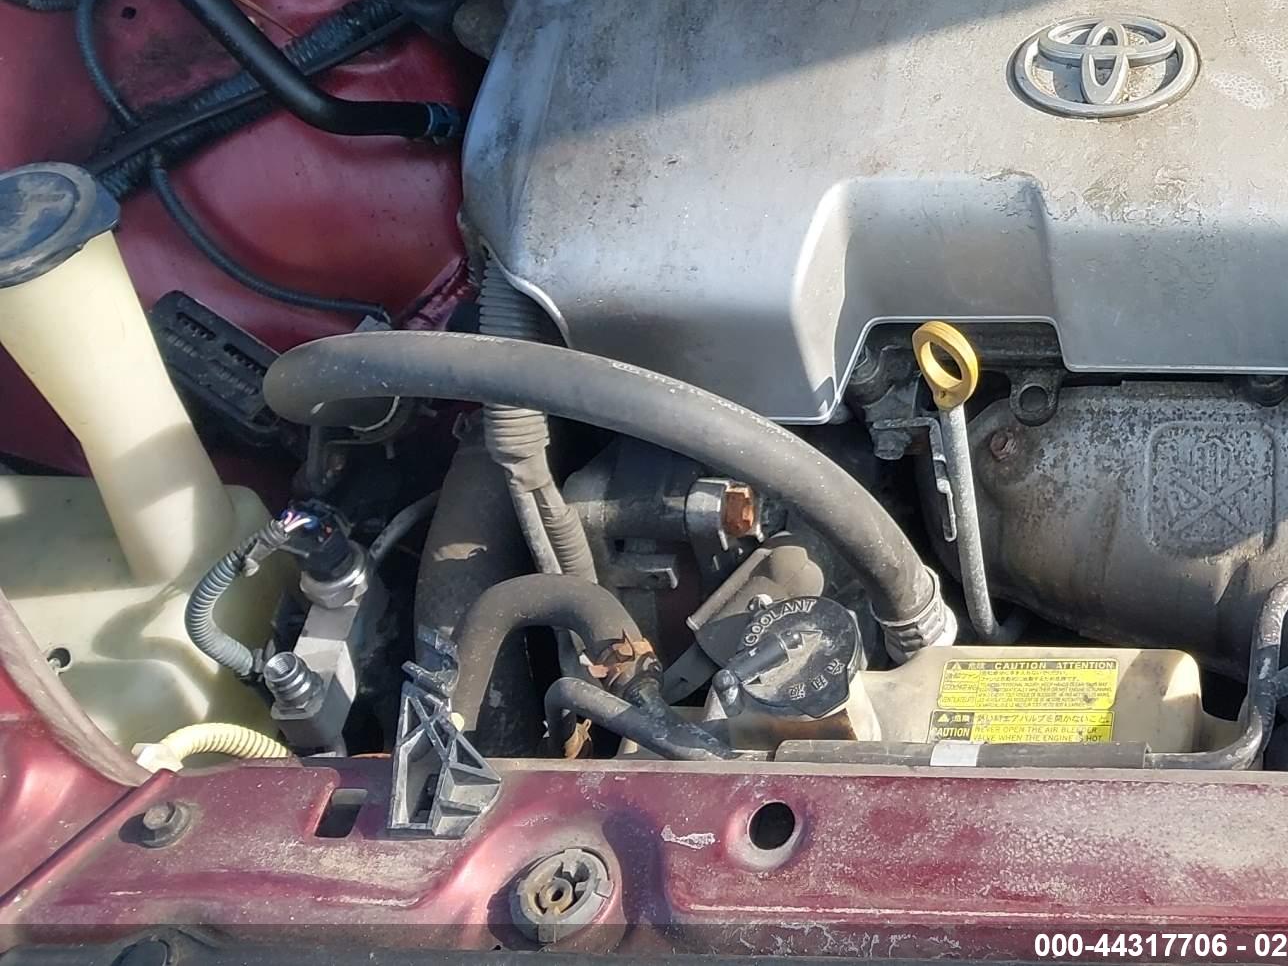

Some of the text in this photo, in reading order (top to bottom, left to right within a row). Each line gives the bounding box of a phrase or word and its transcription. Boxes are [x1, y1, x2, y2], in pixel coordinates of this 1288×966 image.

[743, 599, 817, 646] COOLANT
[994, 661, 1114, 670] CAUTION ATTENTION
[999, 734, 1024, 742] WHEN
[1026, 734, 1041, 742] THE
[1043, 734, 1074, 742] ENGINE
[1085, 734, 1104, 742] HOT
